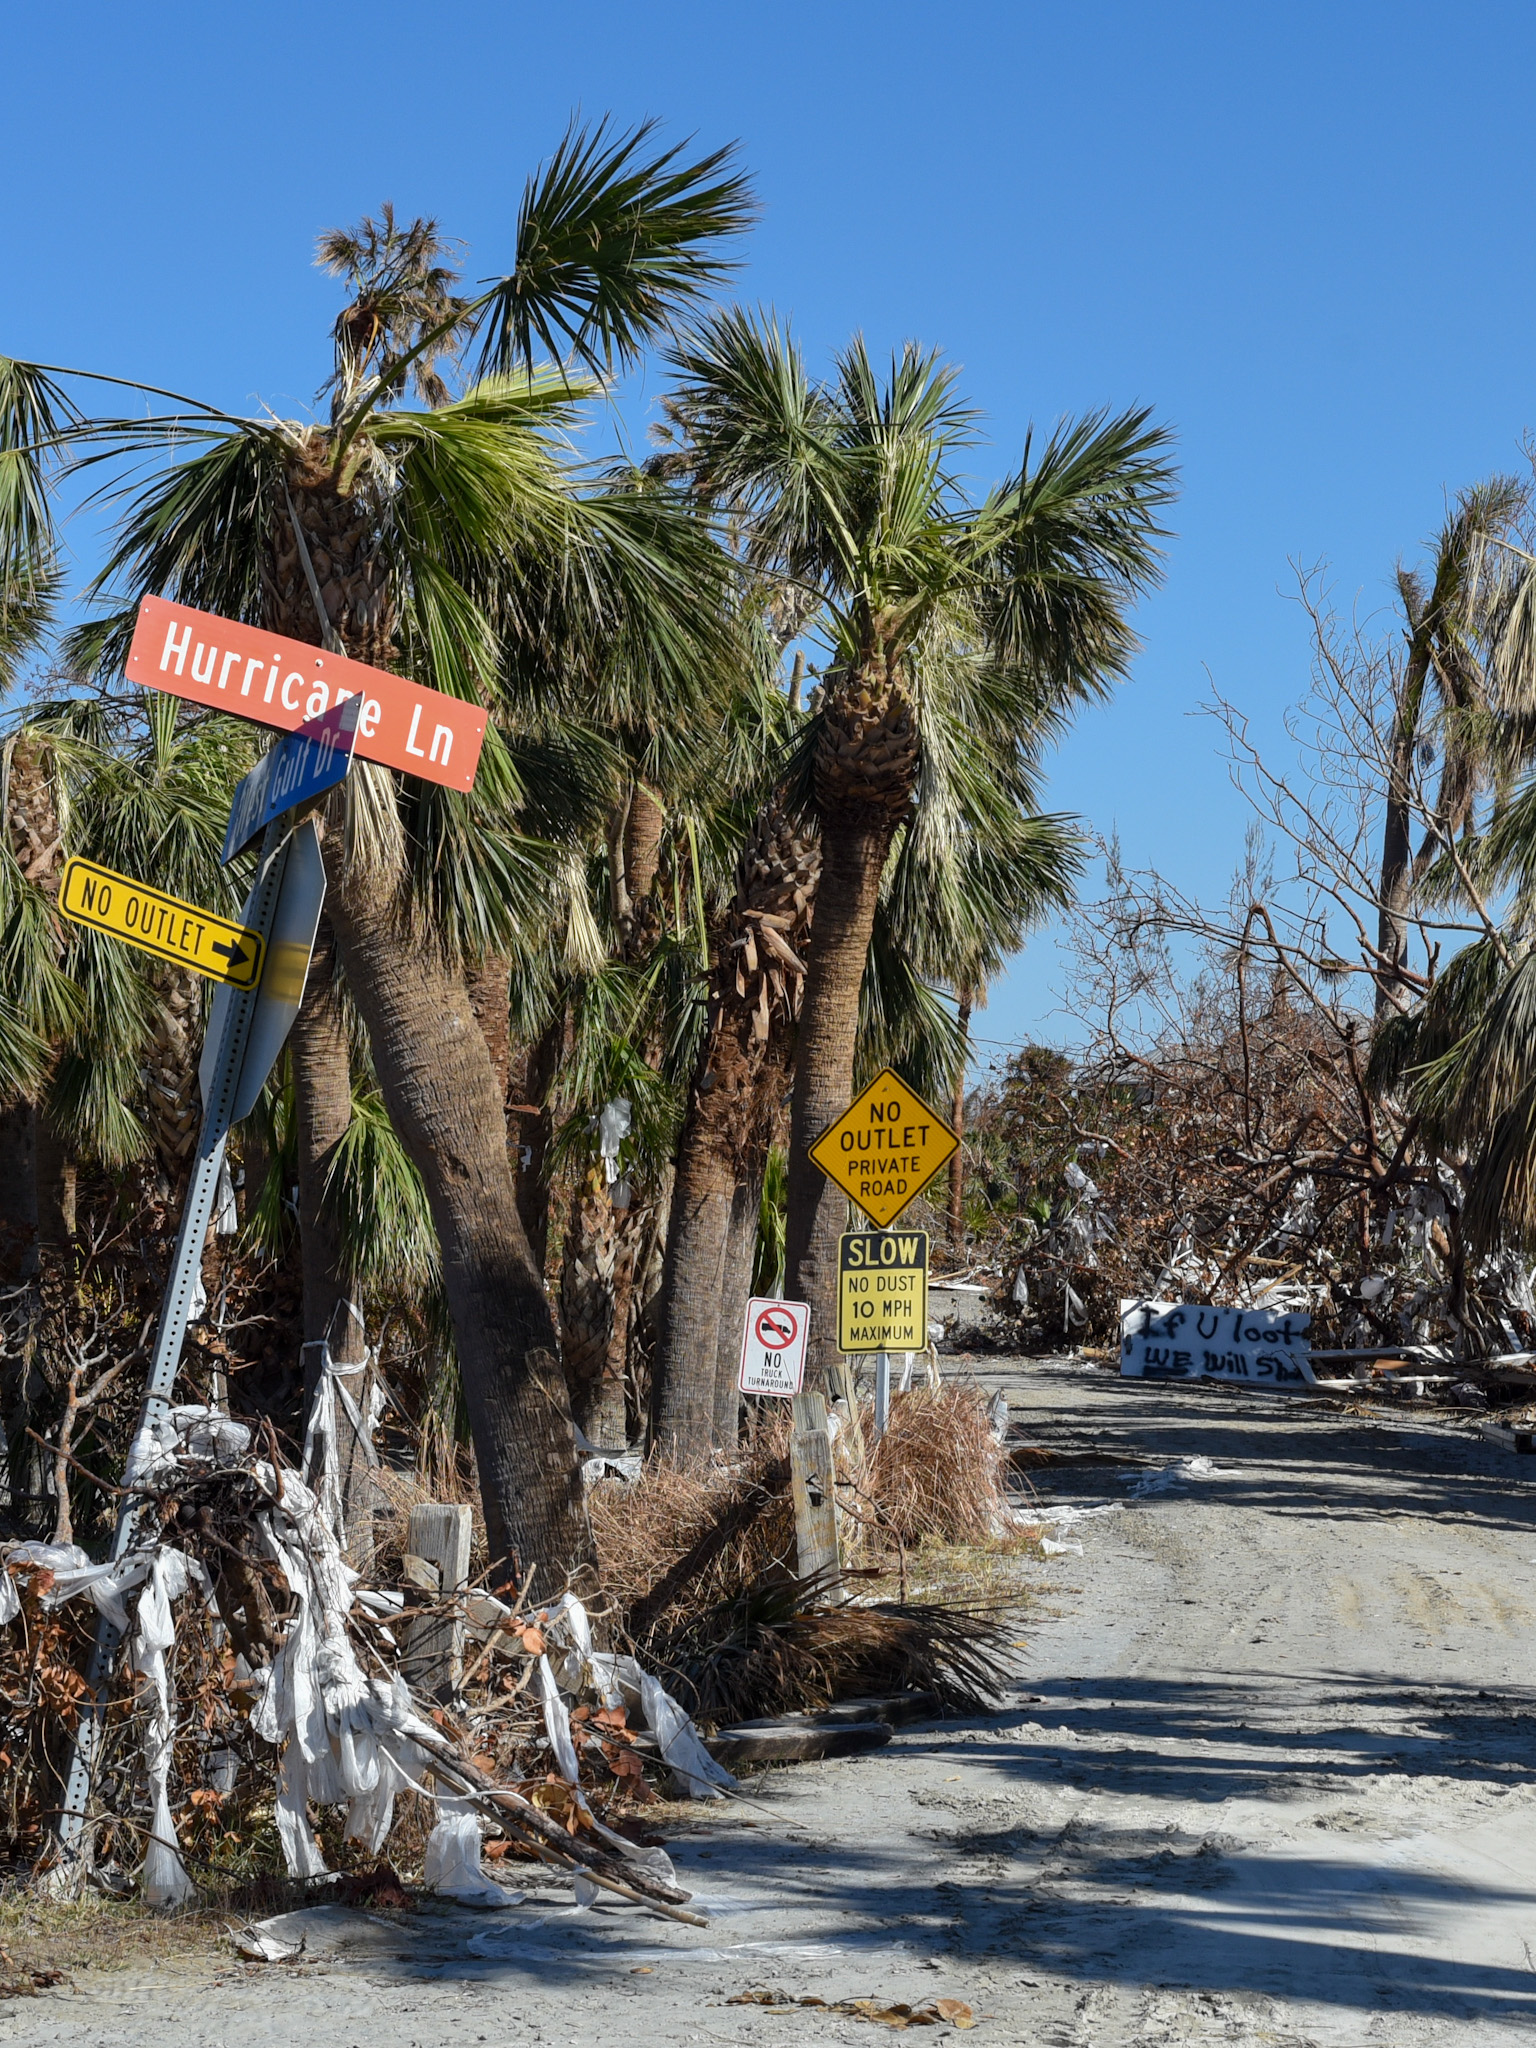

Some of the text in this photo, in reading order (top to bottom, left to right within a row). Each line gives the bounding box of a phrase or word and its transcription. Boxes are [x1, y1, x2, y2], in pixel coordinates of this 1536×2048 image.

[405, 703, 454, 766] Ln
[272, 735, 312, 803] Gulf
[313, 726, 340, 779] Dr
[81, 877, 205, 955] NO OUTLET
[870, 1101, 901, 1123] NO
[840, 1126, 930, 1152] OUTLET
[848, 1157, 921, 1176] PRIVATE
[860, 1179, 908, 1197] ROAD
[848, 1237, 919, 1266] SLOW
[849, 1275, 916, 1293] NO DUST
[853, 1300, 912, 1319] 10 MPH
[850, 1325, 914, 1341] MAXIMUM
[1197, 1312, 1219, 1340] U
[764, 1351, 782, 1368] NO
[748, 1376, 794, 1390] TURNAROUND
[761, 1368, 783, 1379] TRUCK
